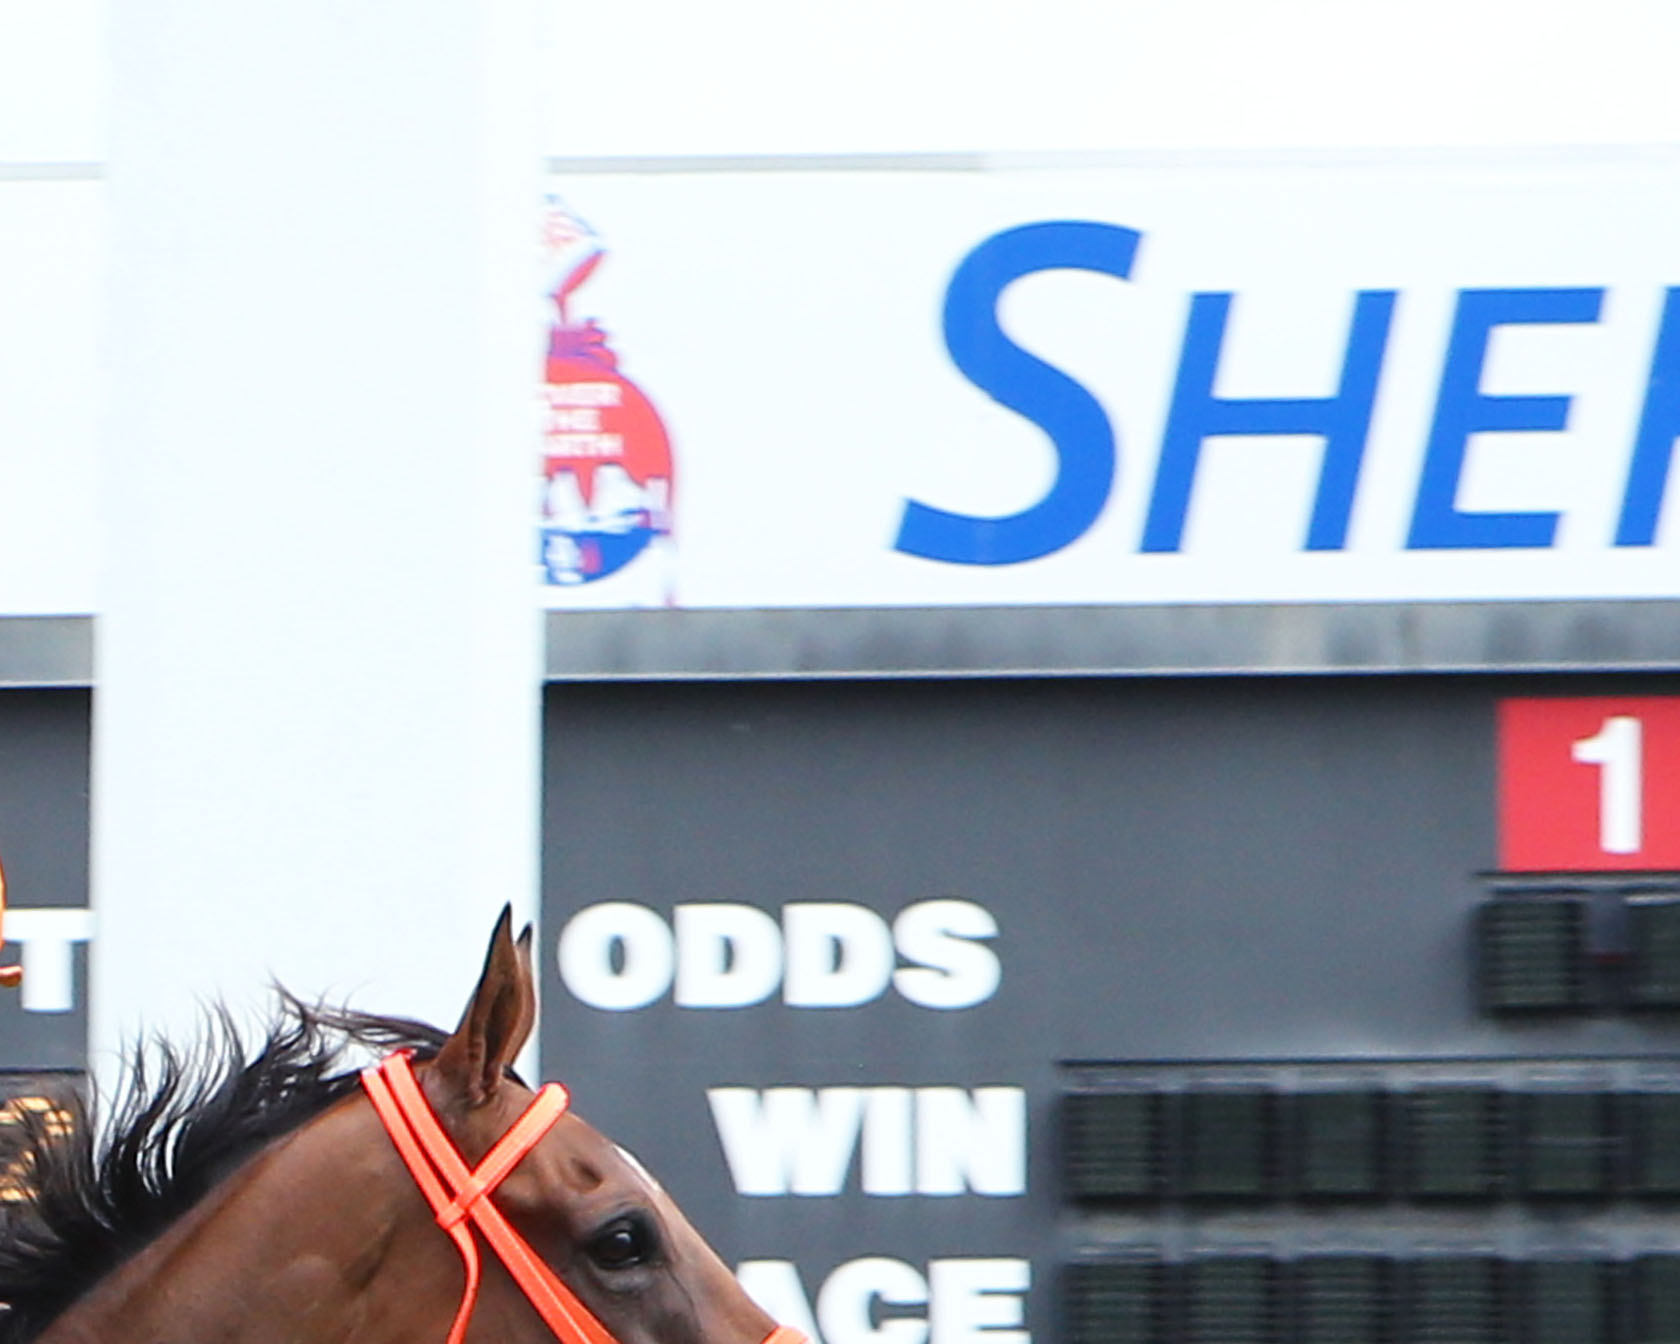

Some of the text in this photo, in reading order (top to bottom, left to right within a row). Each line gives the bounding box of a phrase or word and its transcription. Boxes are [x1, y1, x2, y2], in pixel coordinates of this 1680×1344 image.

[1571, 715, 1644, 854] 1
[558, 899, 1002, 1010] ODDS
[708, 1086, 1027, 1197] WIN
